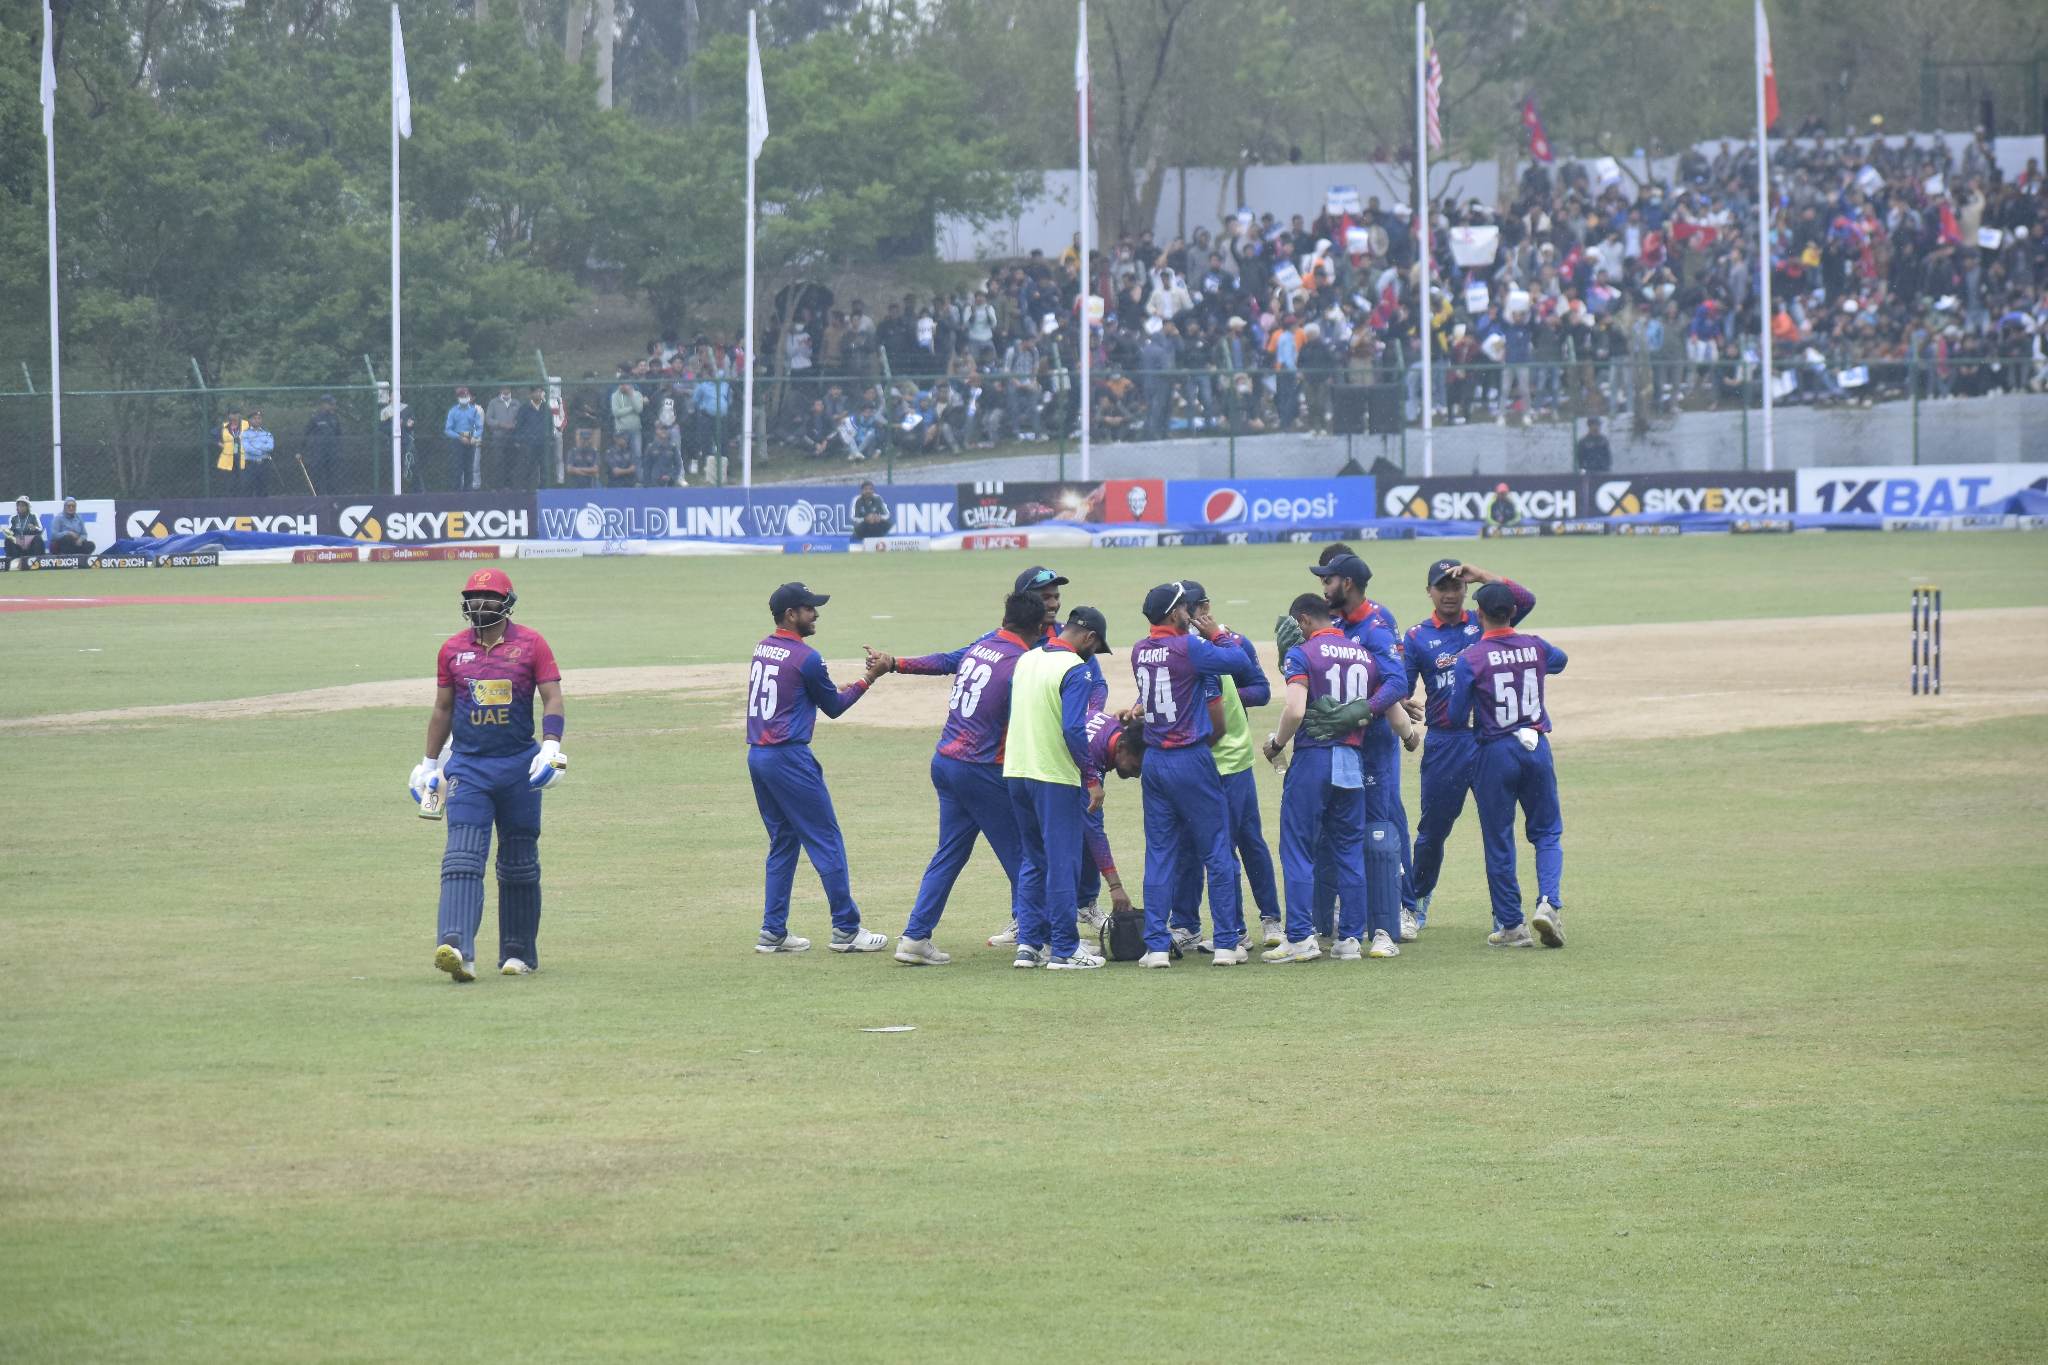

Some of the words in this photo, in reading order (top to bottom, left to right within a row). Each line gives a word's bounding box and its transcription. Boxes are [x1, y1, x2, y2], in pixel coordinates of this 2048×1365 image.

[1252, 492, 1338, 522] pepsi
[1432, 490, 1576, 520] SKYXCH
[1644, 487, 1789, 514] SKYEXCH
[1816, 477, 1992, 516] 1XBAT
[174, 514, 318, 537] SKYEXCH
[386, 509, 529, 540] SKYEXCH
[542, 503, 746, 540] WORLDLINK
[753, 499, 955, 537] WORLINK
[963, 505, 1017, 527] CHIZZA
[988, 535, 1021, 549] KFC
[40, 557, 78, 567] SKYEXCH
[102, 557, 145, 568] SKYEXCH
[172, 554, 216, 566] SKYEXCH
[970, 644, 1004, 663] KARAN
[1137, 646, 1170, 663] AARIF
[1320, 643, 1372, 664] SOMPAL
[1488, 646, 1538, 666] BHIM
[749, 660, 779, 720] 25
[949, 657, 993, 718] 33
[1137, 666, 1178, 723] 24
[1325, 663, 1368, 706] 10
[1493, 667, 1542, 729] 54
[470, 707, 511, 726] UAE
